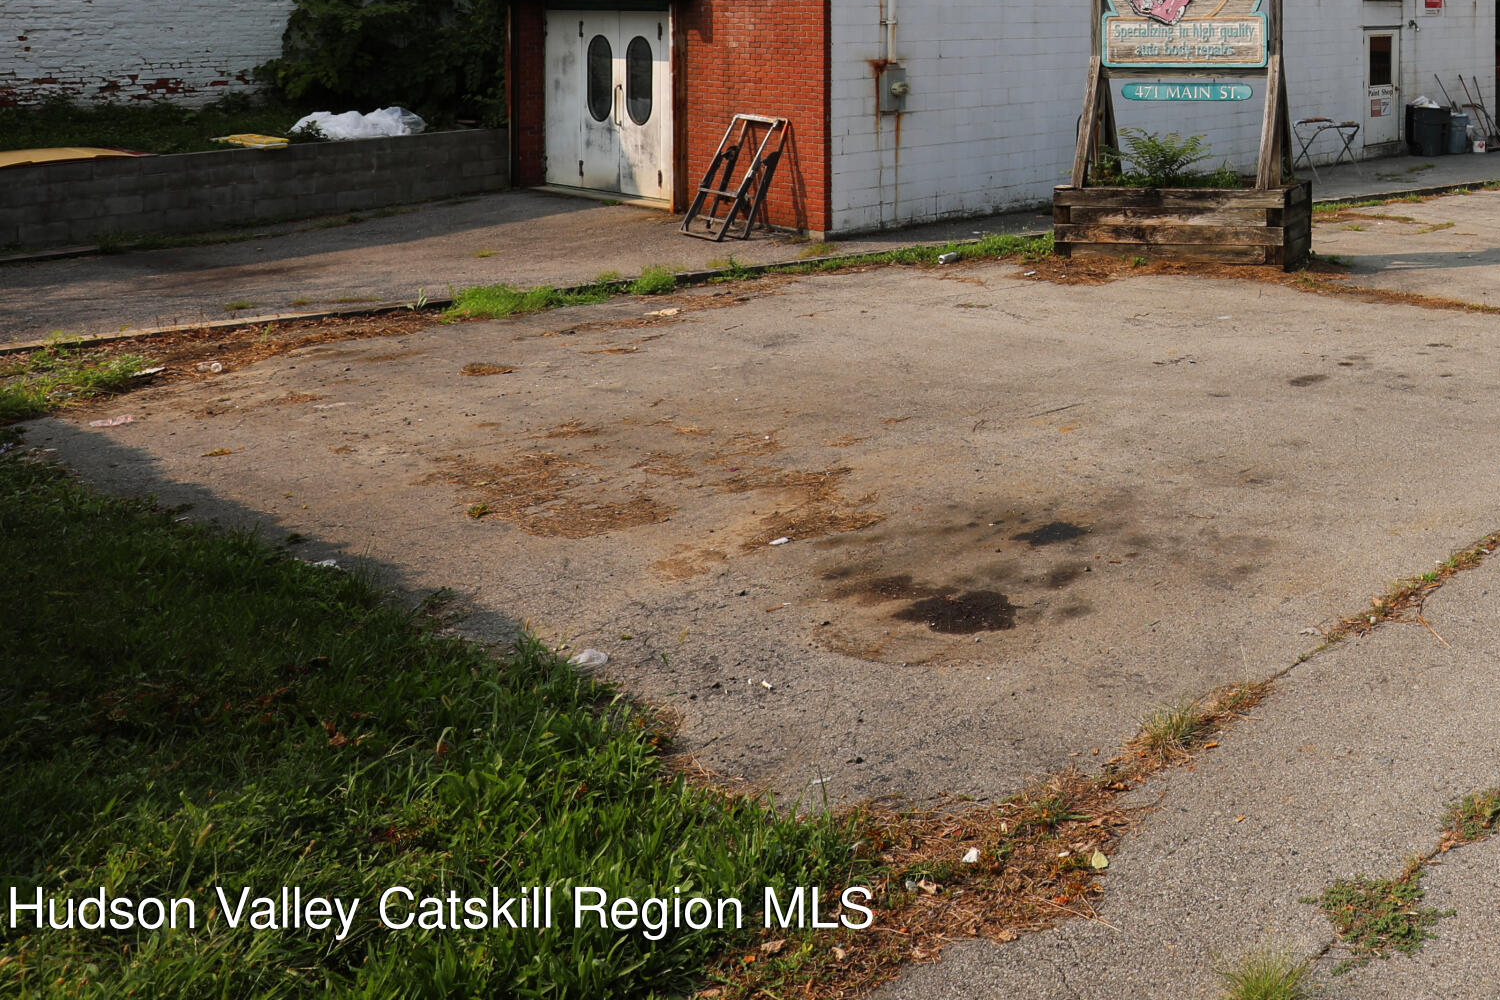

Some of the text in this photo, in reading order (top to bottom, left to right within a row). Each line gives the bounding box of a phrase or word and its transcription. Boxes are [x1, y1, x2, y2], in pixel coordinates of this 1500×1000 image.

[1114, 24, 1255, 42] Specializing in high quality
[1135, 43, 1160, 57] auto
[1164, 42, 1192, 59] body
[1196, 43, 1235, 60] repairs
[1135, 86, 1241, 99] 471 MAIN ST.
